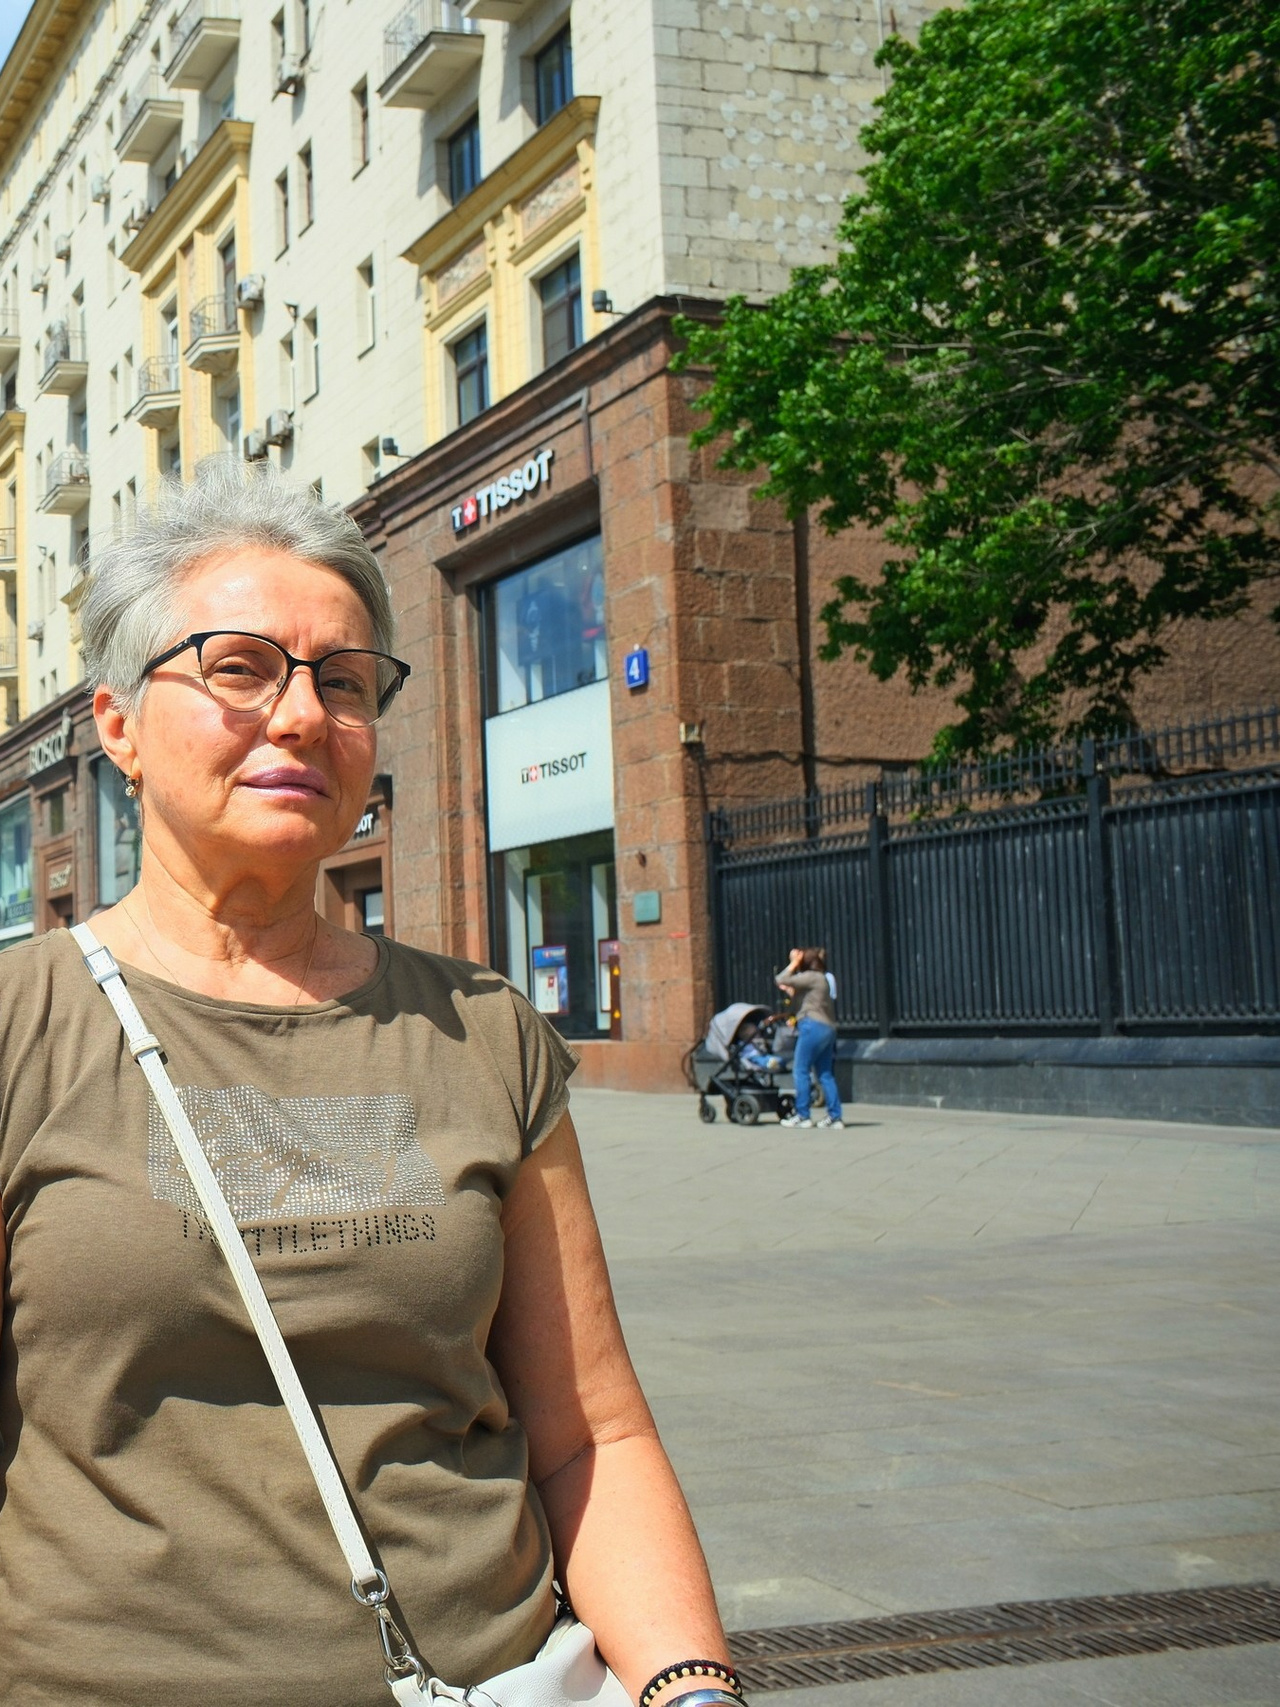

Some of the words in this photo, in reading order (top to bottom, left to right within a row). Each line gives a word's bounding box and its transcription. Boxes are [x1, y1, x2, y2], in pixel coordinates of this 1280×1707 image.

[476, 449, 553, 517] TISSOT
[628, 656, 640, 680] 4
[539, 752, 587, 779] TISSOT
